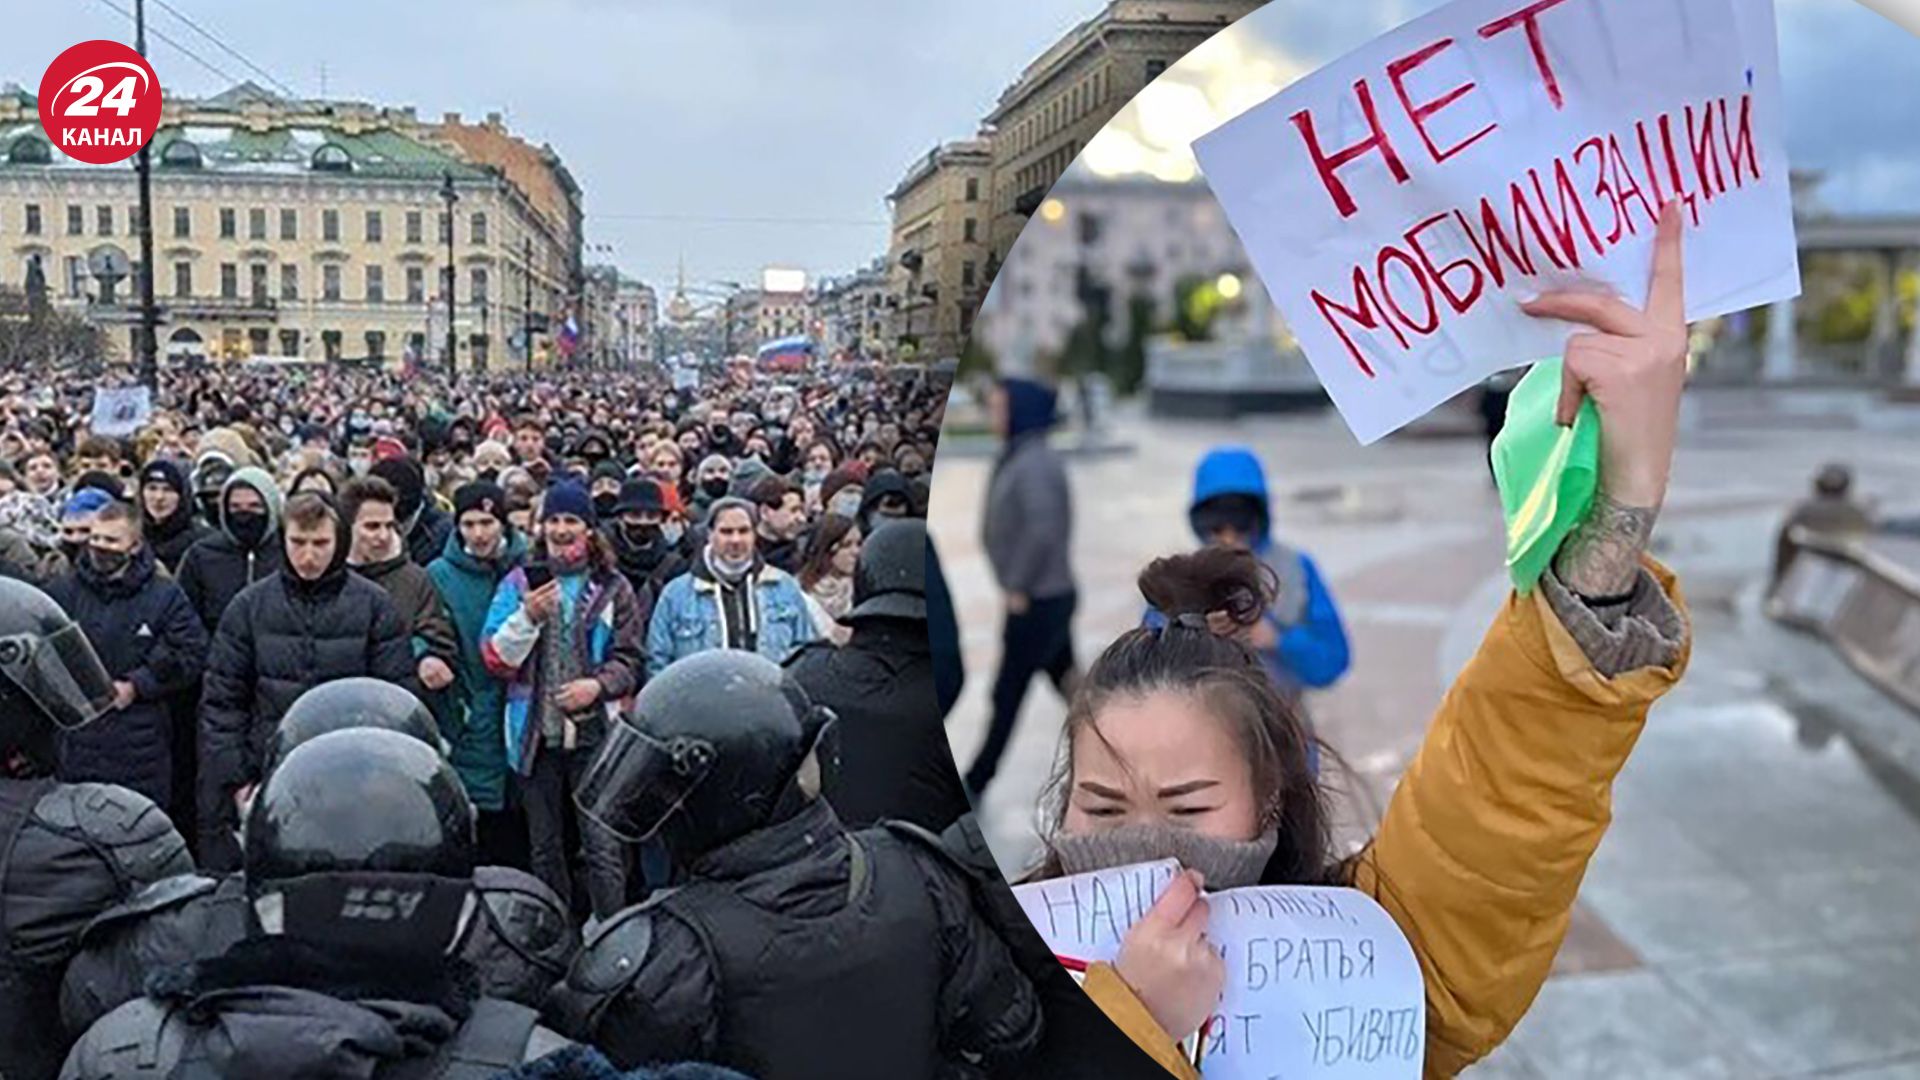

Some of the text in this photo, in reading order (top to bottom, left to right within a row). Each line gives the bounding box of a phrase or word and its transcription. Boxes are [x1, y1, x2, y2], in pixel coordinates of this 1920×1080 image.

[1289, 0, 1568, 218] НЕТ
[1040, 866, 1181, 945] НАШ
[1247, 936, 1375, 991] БРАТЬЯ
[1301, 1005, 1419, 1067] УБИВАТЬ
